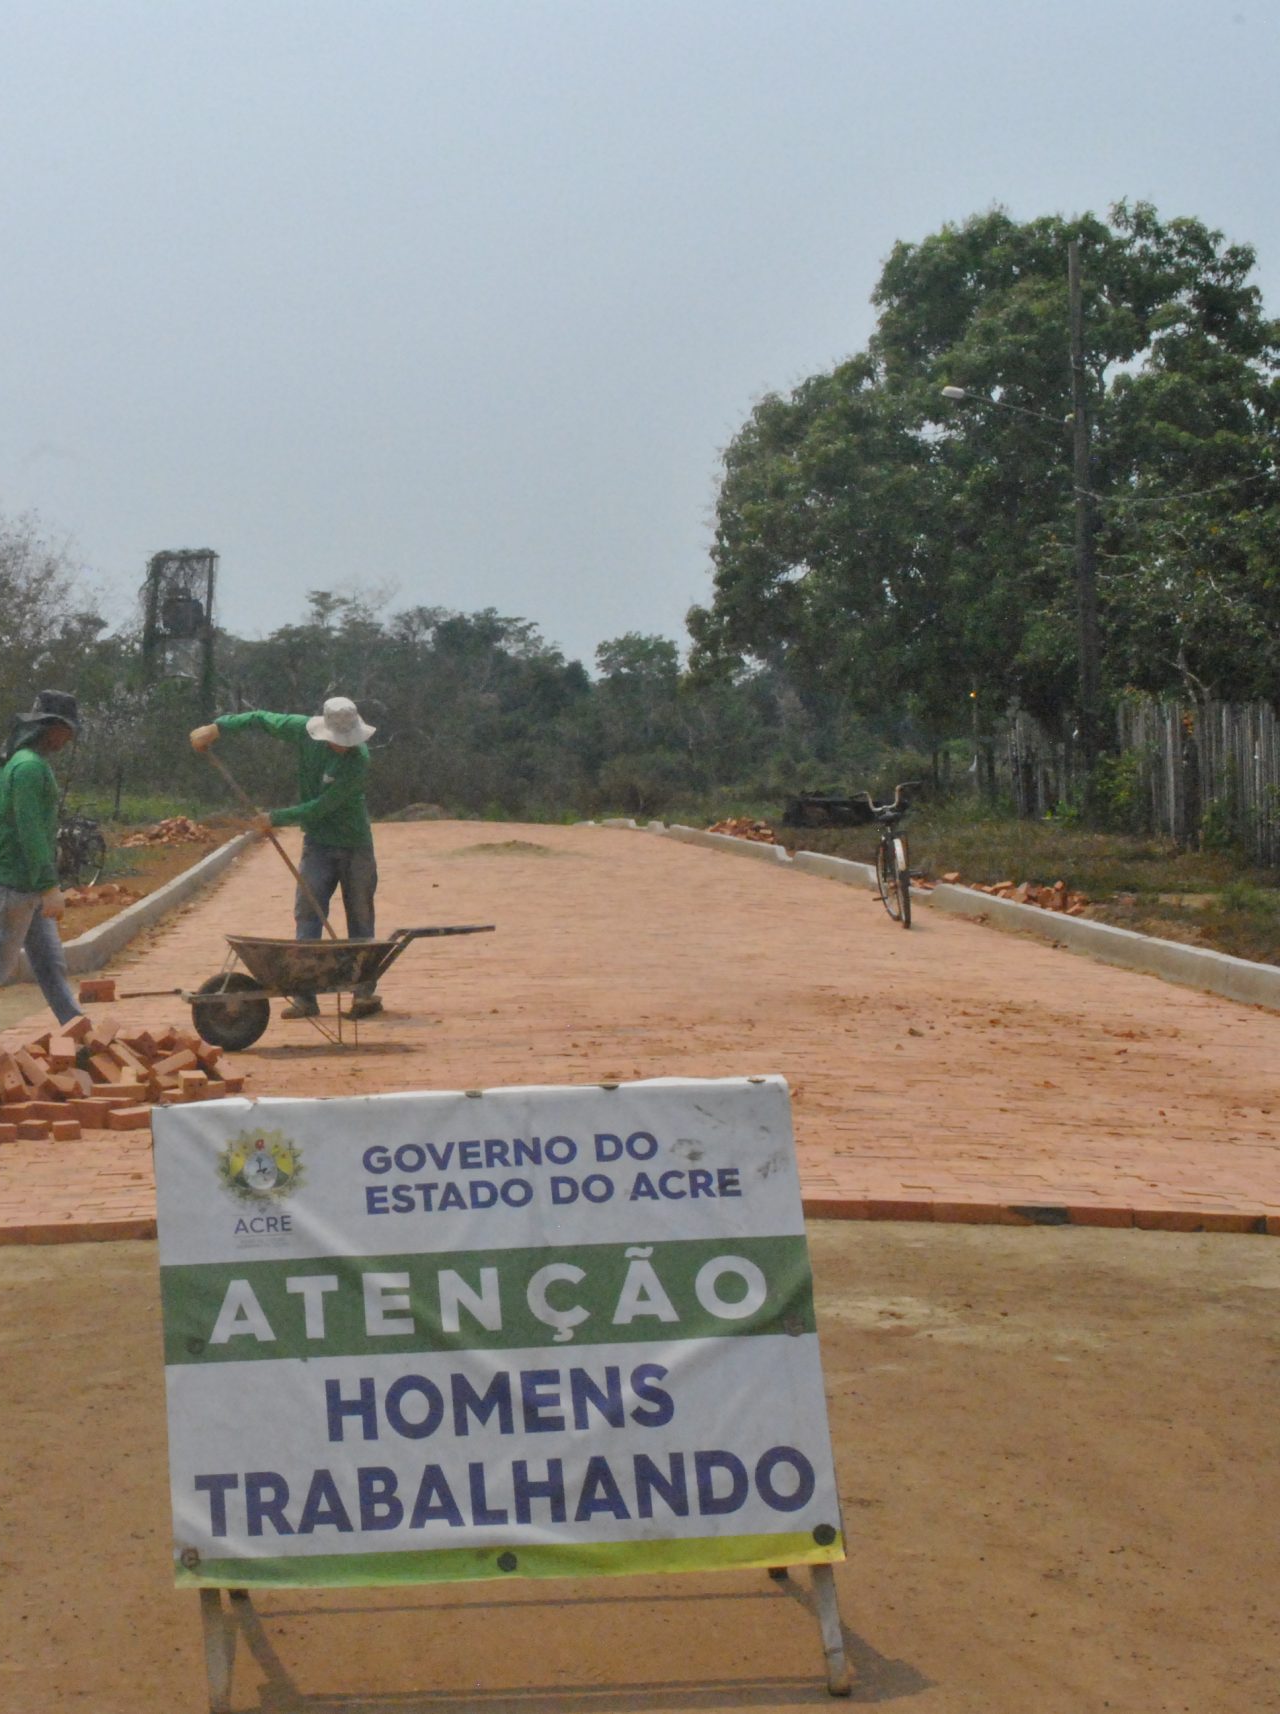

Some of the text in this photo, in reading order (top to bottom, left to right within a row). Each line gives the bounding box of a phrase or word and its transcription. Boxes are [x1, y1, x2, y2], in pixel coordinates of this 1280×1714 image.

[362, 1131, 658, 1174] GOVERNO DO
[366, 1168, 742, 1214] ESTADO DO ACRE
[234, 1215, 293, 1234] ACRE
[208, 1247, 768, 1342] ATENÇÃO
[324, 1364, 675, 1442] HOMENS
[194, 1446, 816, 1537] TRABALHANDO
